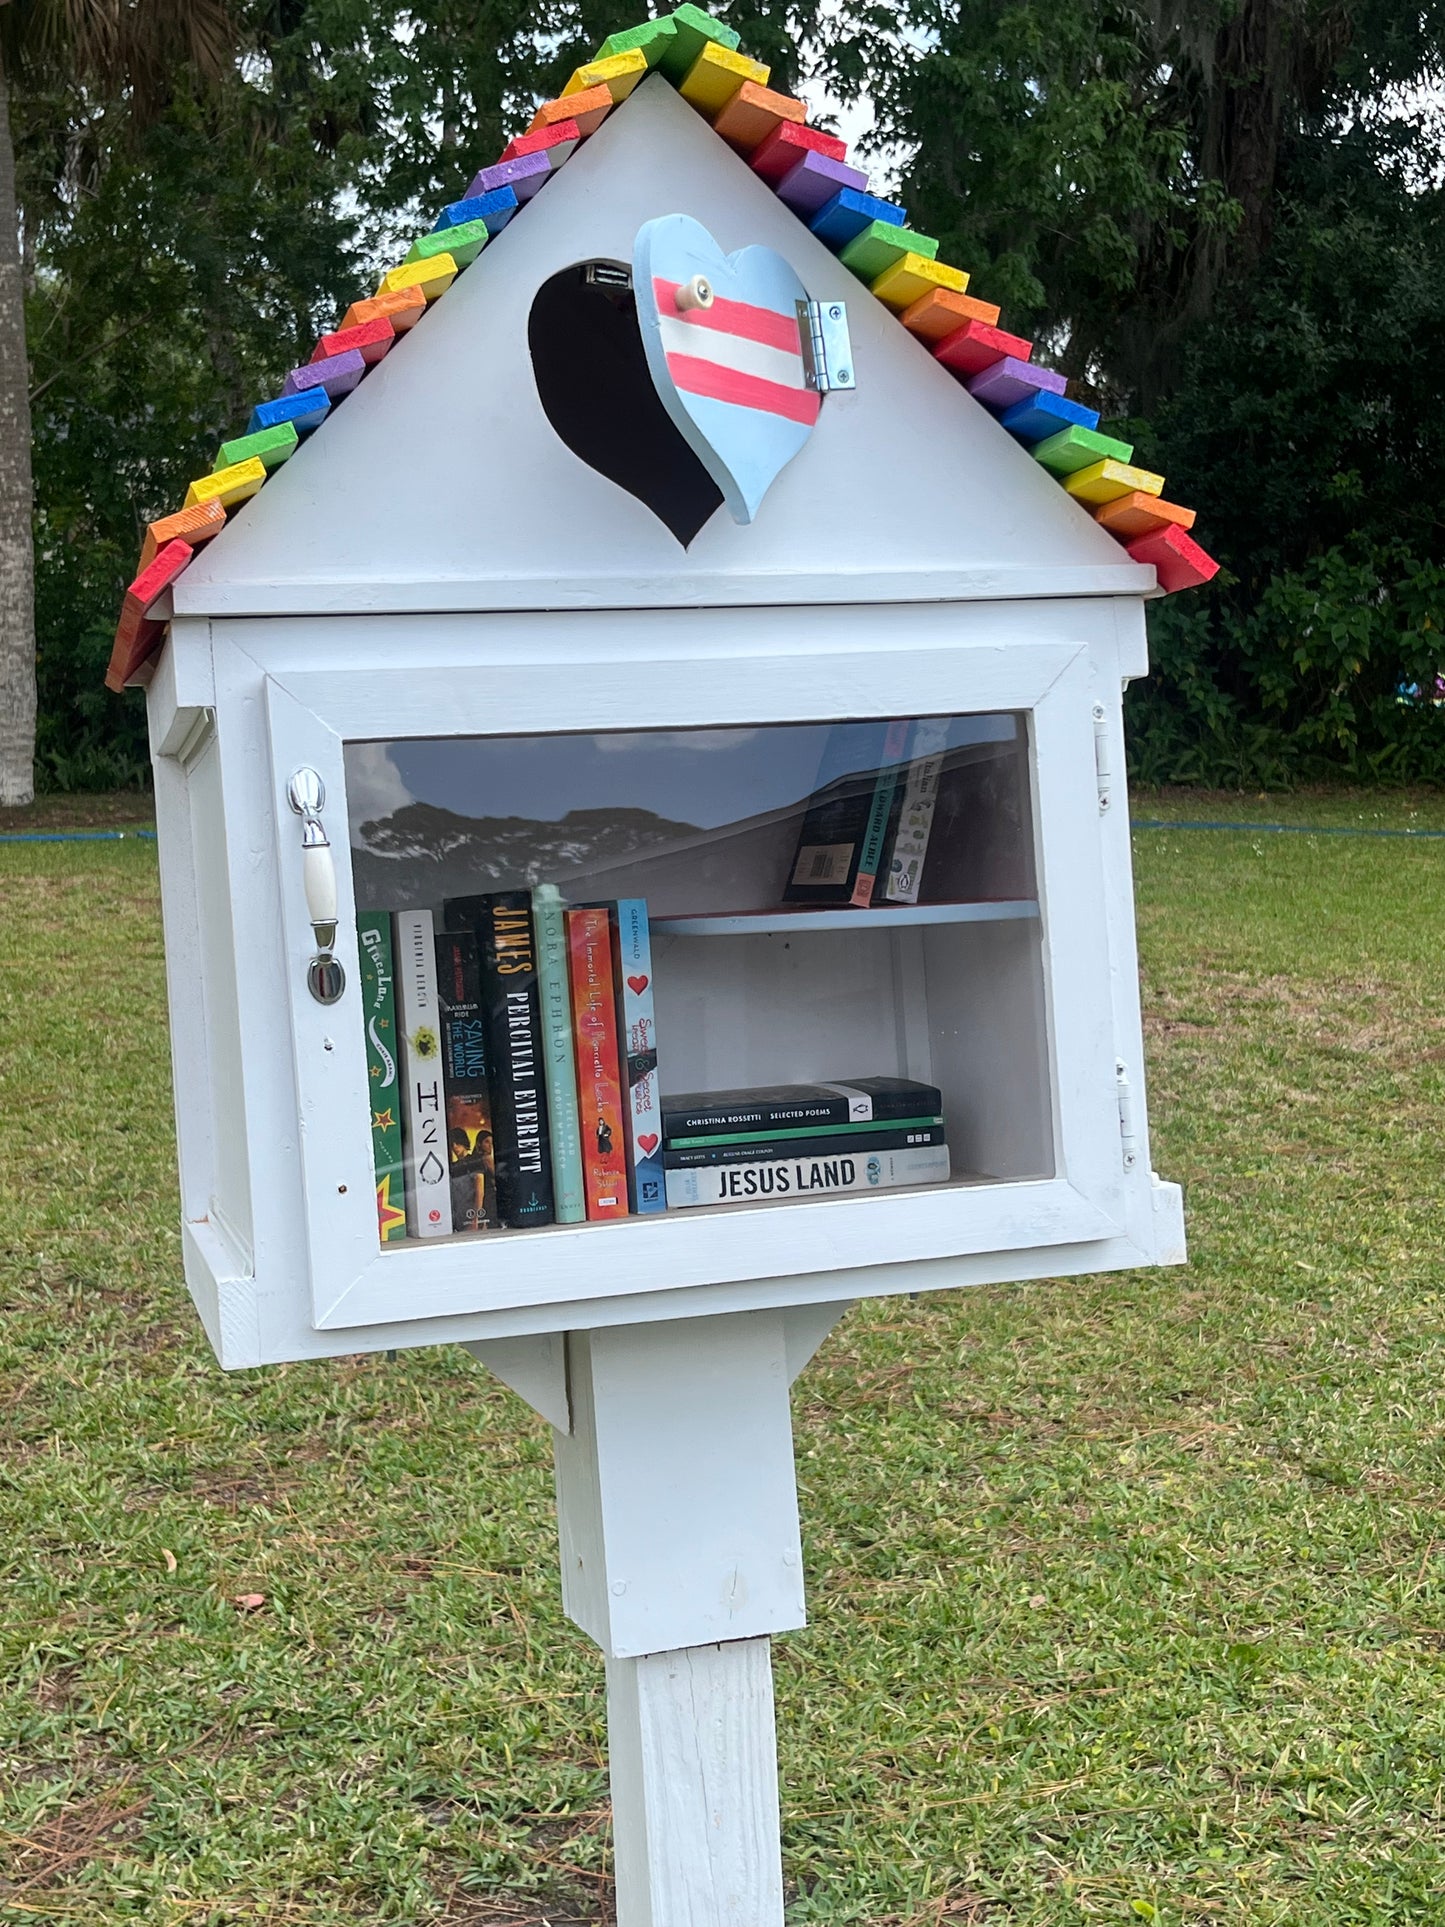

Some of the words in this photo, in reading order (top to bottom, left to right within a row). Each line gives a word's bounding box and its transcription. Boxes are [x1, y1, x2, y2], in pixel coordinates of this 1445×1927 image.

[920, 761, 935, 793] Italian
[865, 837, 877, 867] ALBEE
[413, 924, 424, 968] VIRGINIA
[492, 906, 533, 975] JAMES
[545, 912, 558, 966] NORA
[585, 919, 598, 937] The
[631, 908, 641, 960] GREENWALD
[586, 942, 601, 986] Immortal
[416, 974, 427, 1008] BERGIN
[586, 992, 603, 1012] Life
[452, 1020, 464, 1040] THE
[454, 1010, 470, 1018] RIDE
[550, 981, 565, 1063] EPHRON
[587, 1016, 604, 1027] of
[462, 1019, 486, 1078] SAVING
[506, 992, 535, 1082] PERCIVAL
[591, 1030, 606, 1078] Henrietta
[639, 1018, 652, 1055] Sweet
[453, 1042, 466, 1078] WORLD
[594, 1082, 610, 1113] Lacks
[641, 1072, 654, 1112] Secret
[513, 1089, 542, 1173] EVERETT
[553, 1081, 563, 1116] ABOUT
[558, 1141, 567, 1169] NECK
[565, 1102, 574, 1128] FEEL
[686, 1115, 727, 1127] CHRISTINA
[728, 1113, 762, 1123] ROSSETTI
[770, 1110, 804, 1120] SELECTED
[805, 1108, 831, 1117] POEMS
[567, 1134, 576, 1156] BAD
[719, 1166, 790, 1198] JESUS
[796, 1159, 856, 1190] LAND
